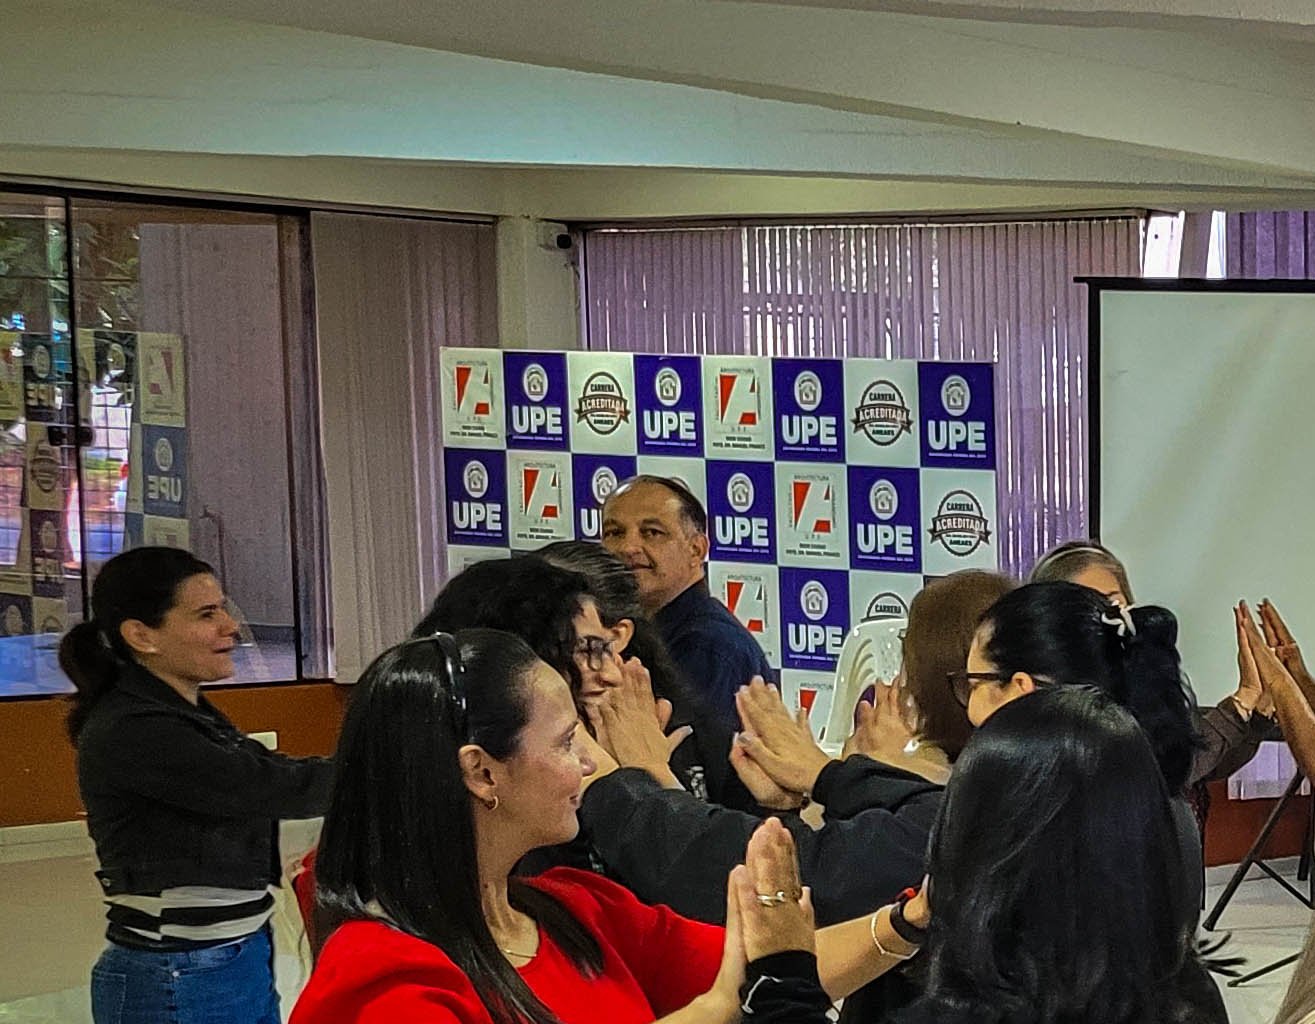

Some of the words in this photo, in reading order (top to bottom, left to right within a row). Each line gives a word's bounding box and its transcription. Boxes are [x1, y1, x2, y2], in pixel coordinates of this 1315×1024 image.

[582, 398, 625, 413] ACREDITADA
[869, 392, 896, 401] CARRERA
[512, 405, 563, 435] UPE
[643, 410, 696, 440] UPE
[859, 407, 907, 422] ACREDITADA
[782, 415, 837, 445] UPE
[928, 420, 986, 451] UPE
[453, 501, 502, 531] UPE
[946, 502, 974, 512] CARRERA
[715, 516, 769, 546] UPE
[856, 523, 914, 555] UPE
[935, 517, 986, 534] ACREDITADA
[875, 604, 902, 613] CARRERA
[788, 624, 843, 655] UPE
